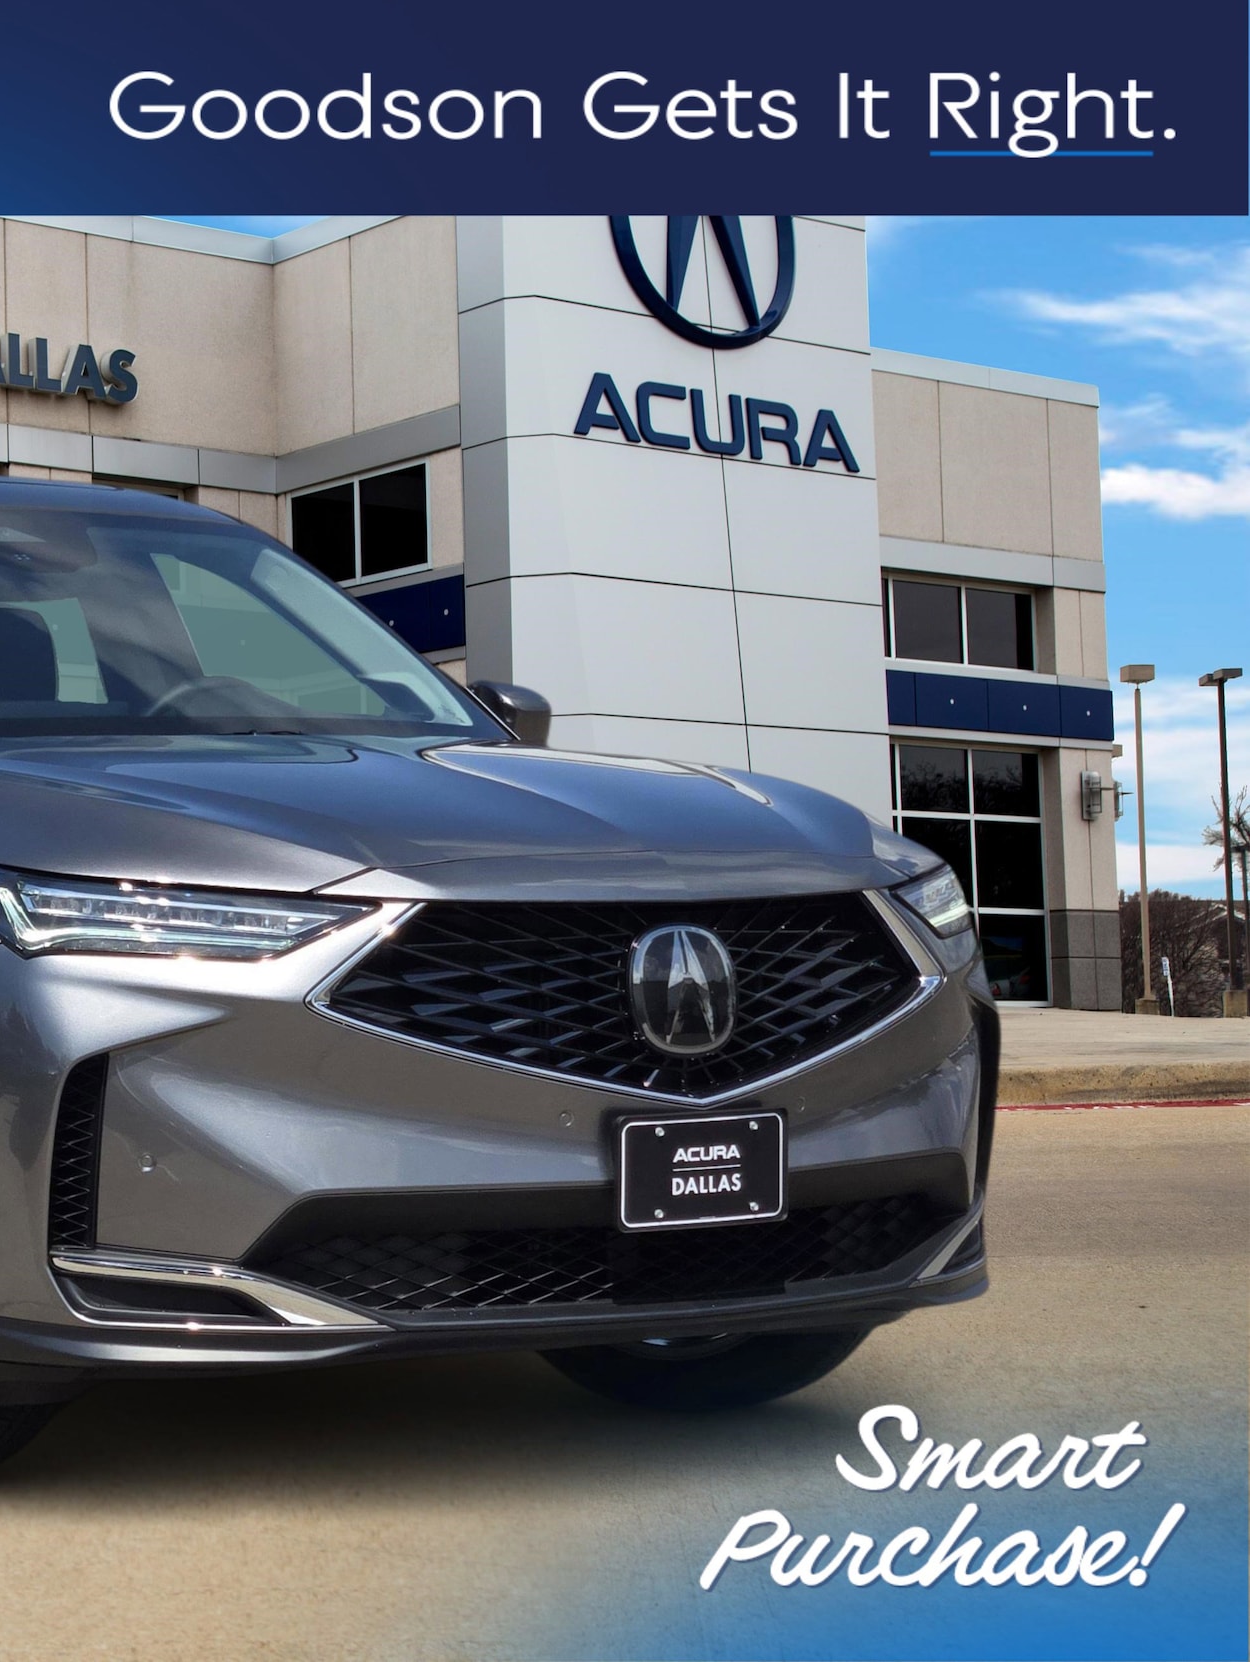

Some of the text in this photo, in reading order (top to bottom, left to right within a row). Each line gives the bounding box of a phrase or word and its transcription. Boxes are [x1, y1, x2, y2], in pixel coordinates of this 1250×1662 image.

[573, 372, 860, 473] ACURA
[672, 1144, 741, 1163] ACURA
[671, 1173, 742, 1196] DALLAS
